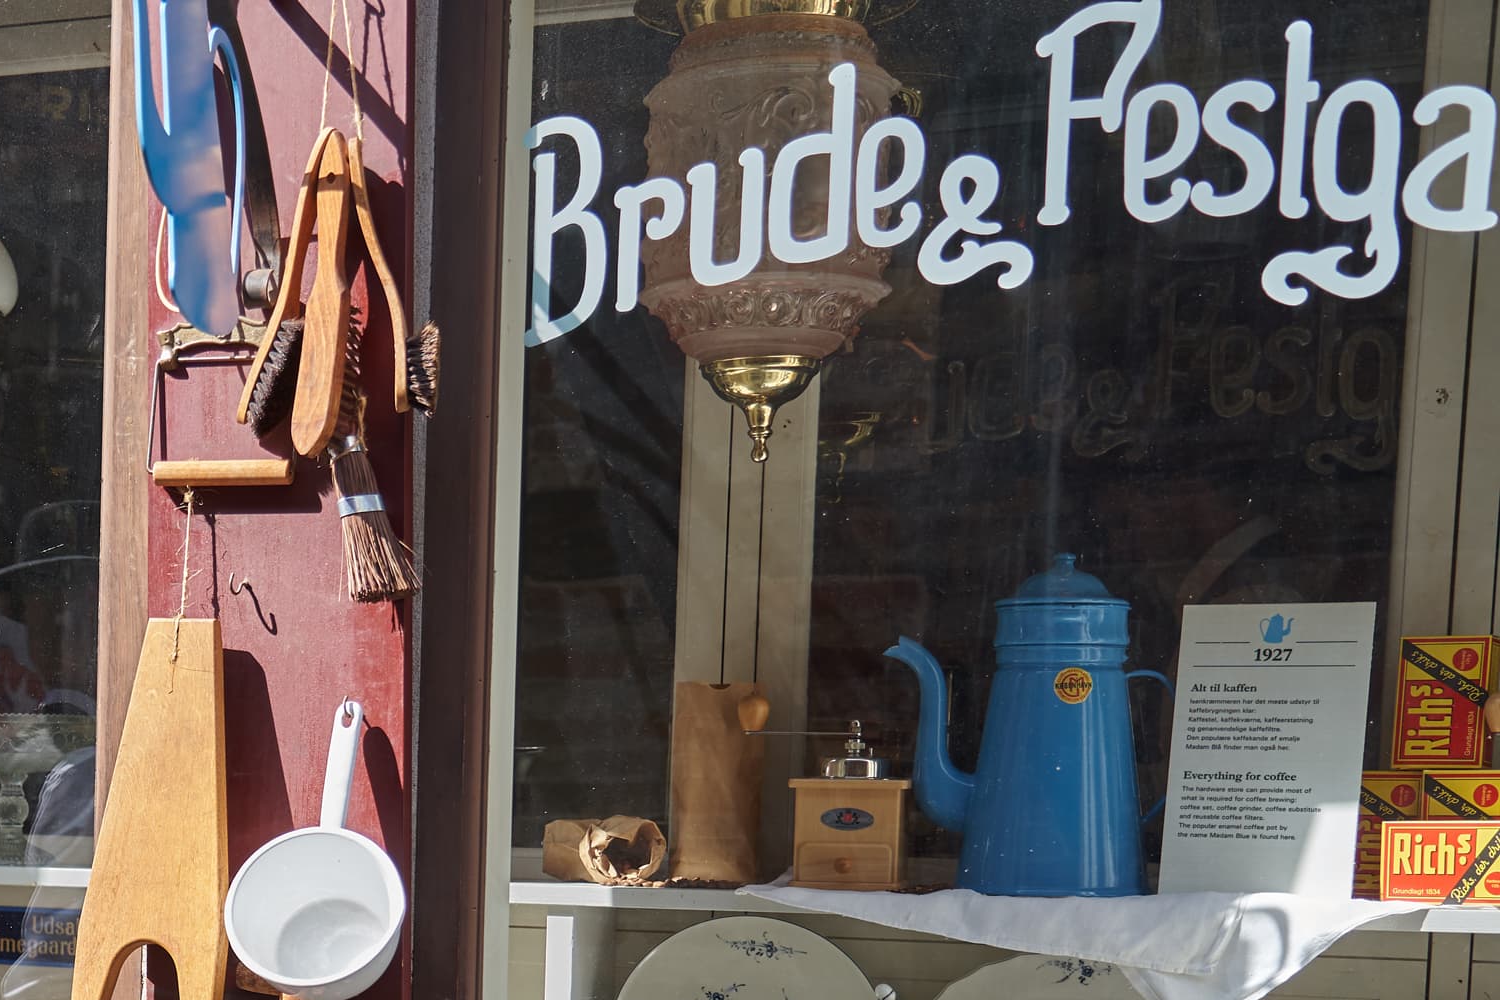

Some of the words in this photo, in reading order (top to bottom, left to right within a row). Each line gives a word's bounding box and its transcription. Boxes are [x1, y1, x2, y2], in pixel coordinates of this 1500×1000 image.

[523, 64, 927, 348] Brude
[918, 154, 1034, 289] &
[1254, 648, 1293, 662] 1927
[1190, 683, 1207, 693] Alt
[1209, 683, 1221, 693] til
[1223, 683, 1257, 693] kaffen
[1183, 771, 1243, 782] Everything
[1246, 771, 1260, 780] for
[1264, 772, 1297, 781] coffee
[32, 915, 79, 936] Udsa
